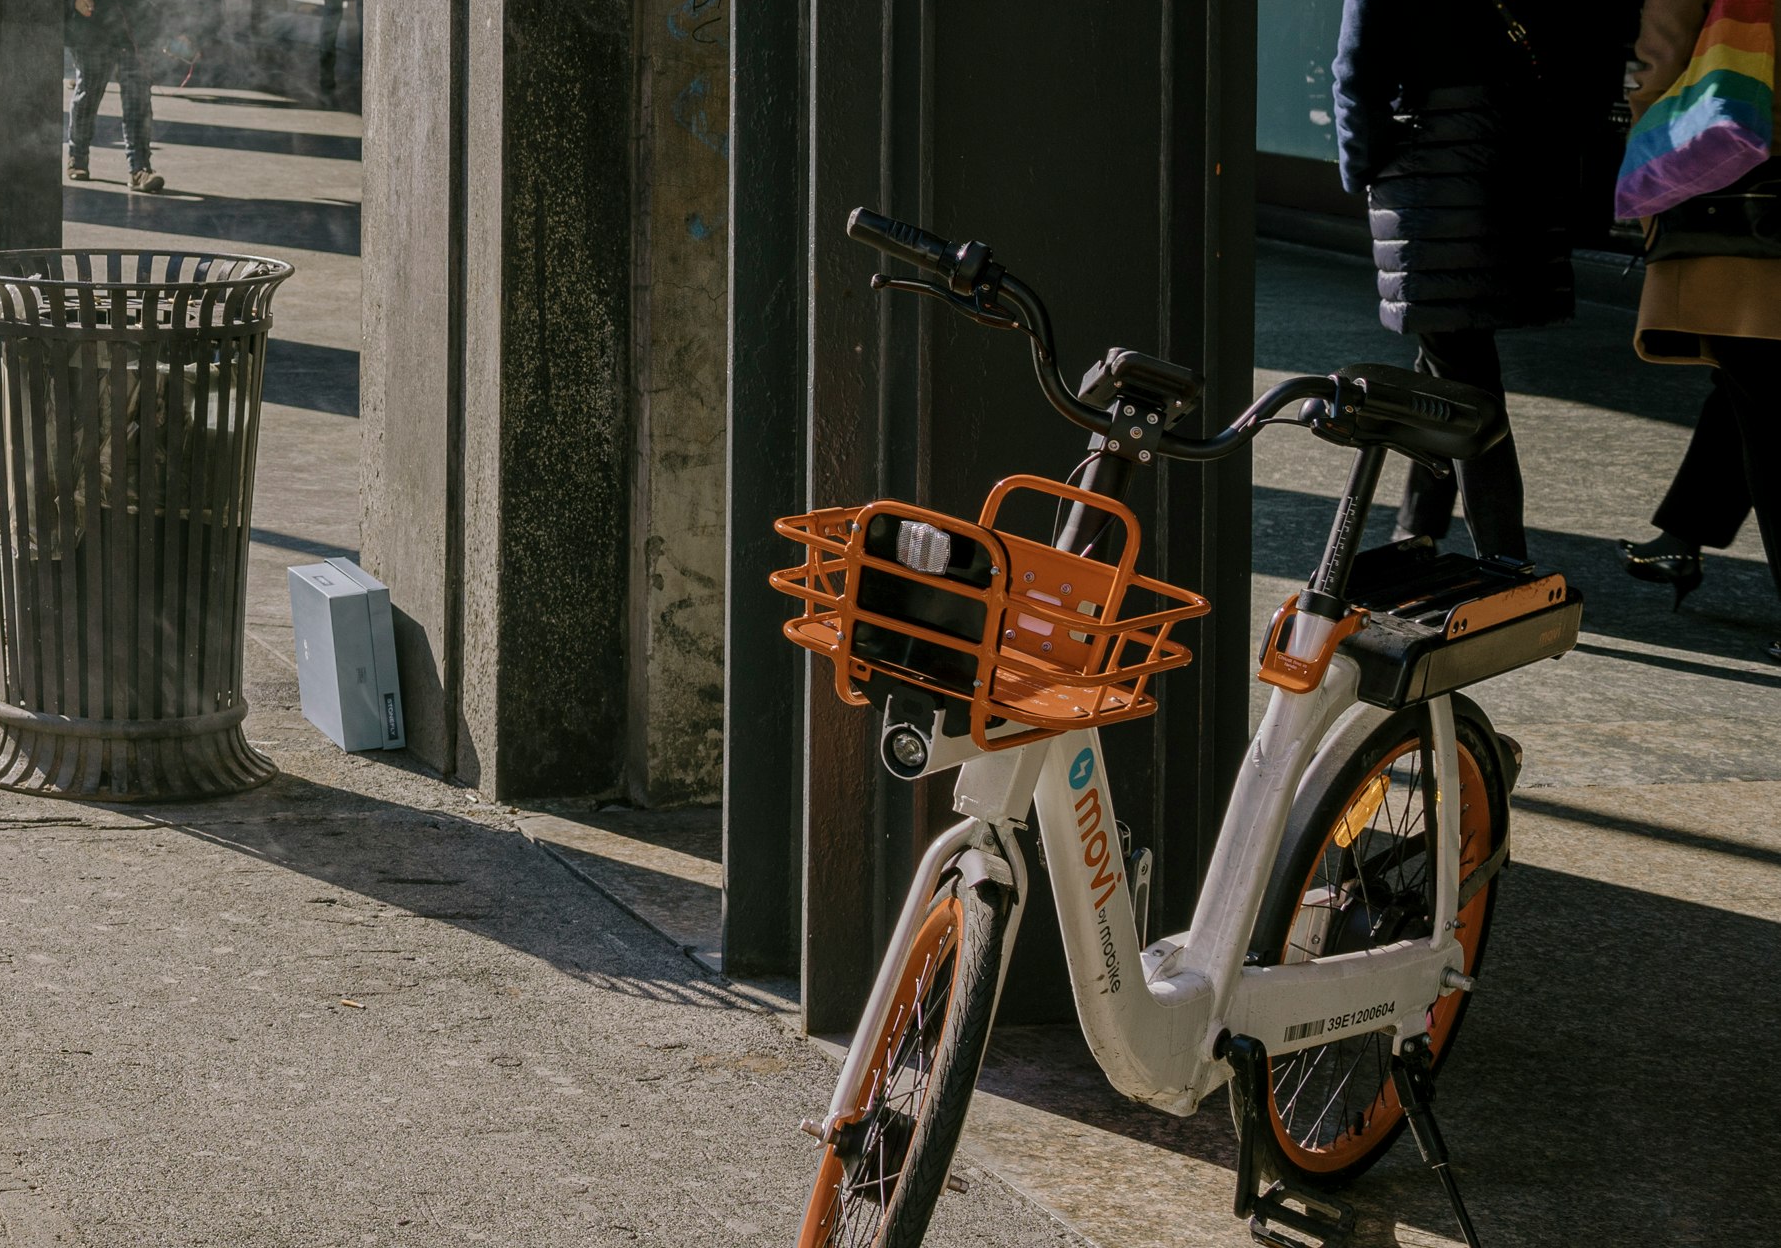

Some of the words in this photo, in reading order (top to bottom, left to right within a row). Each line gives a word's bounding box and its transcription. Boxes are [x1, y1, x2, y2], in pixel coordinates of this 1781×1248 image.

[1074, 787, 1122, 911] movi
[1097, 906, 1108, 926] by
[1099, 924, 1121, 994] mobike
[1327, 1000, 1396, 1032] 39E1200604
